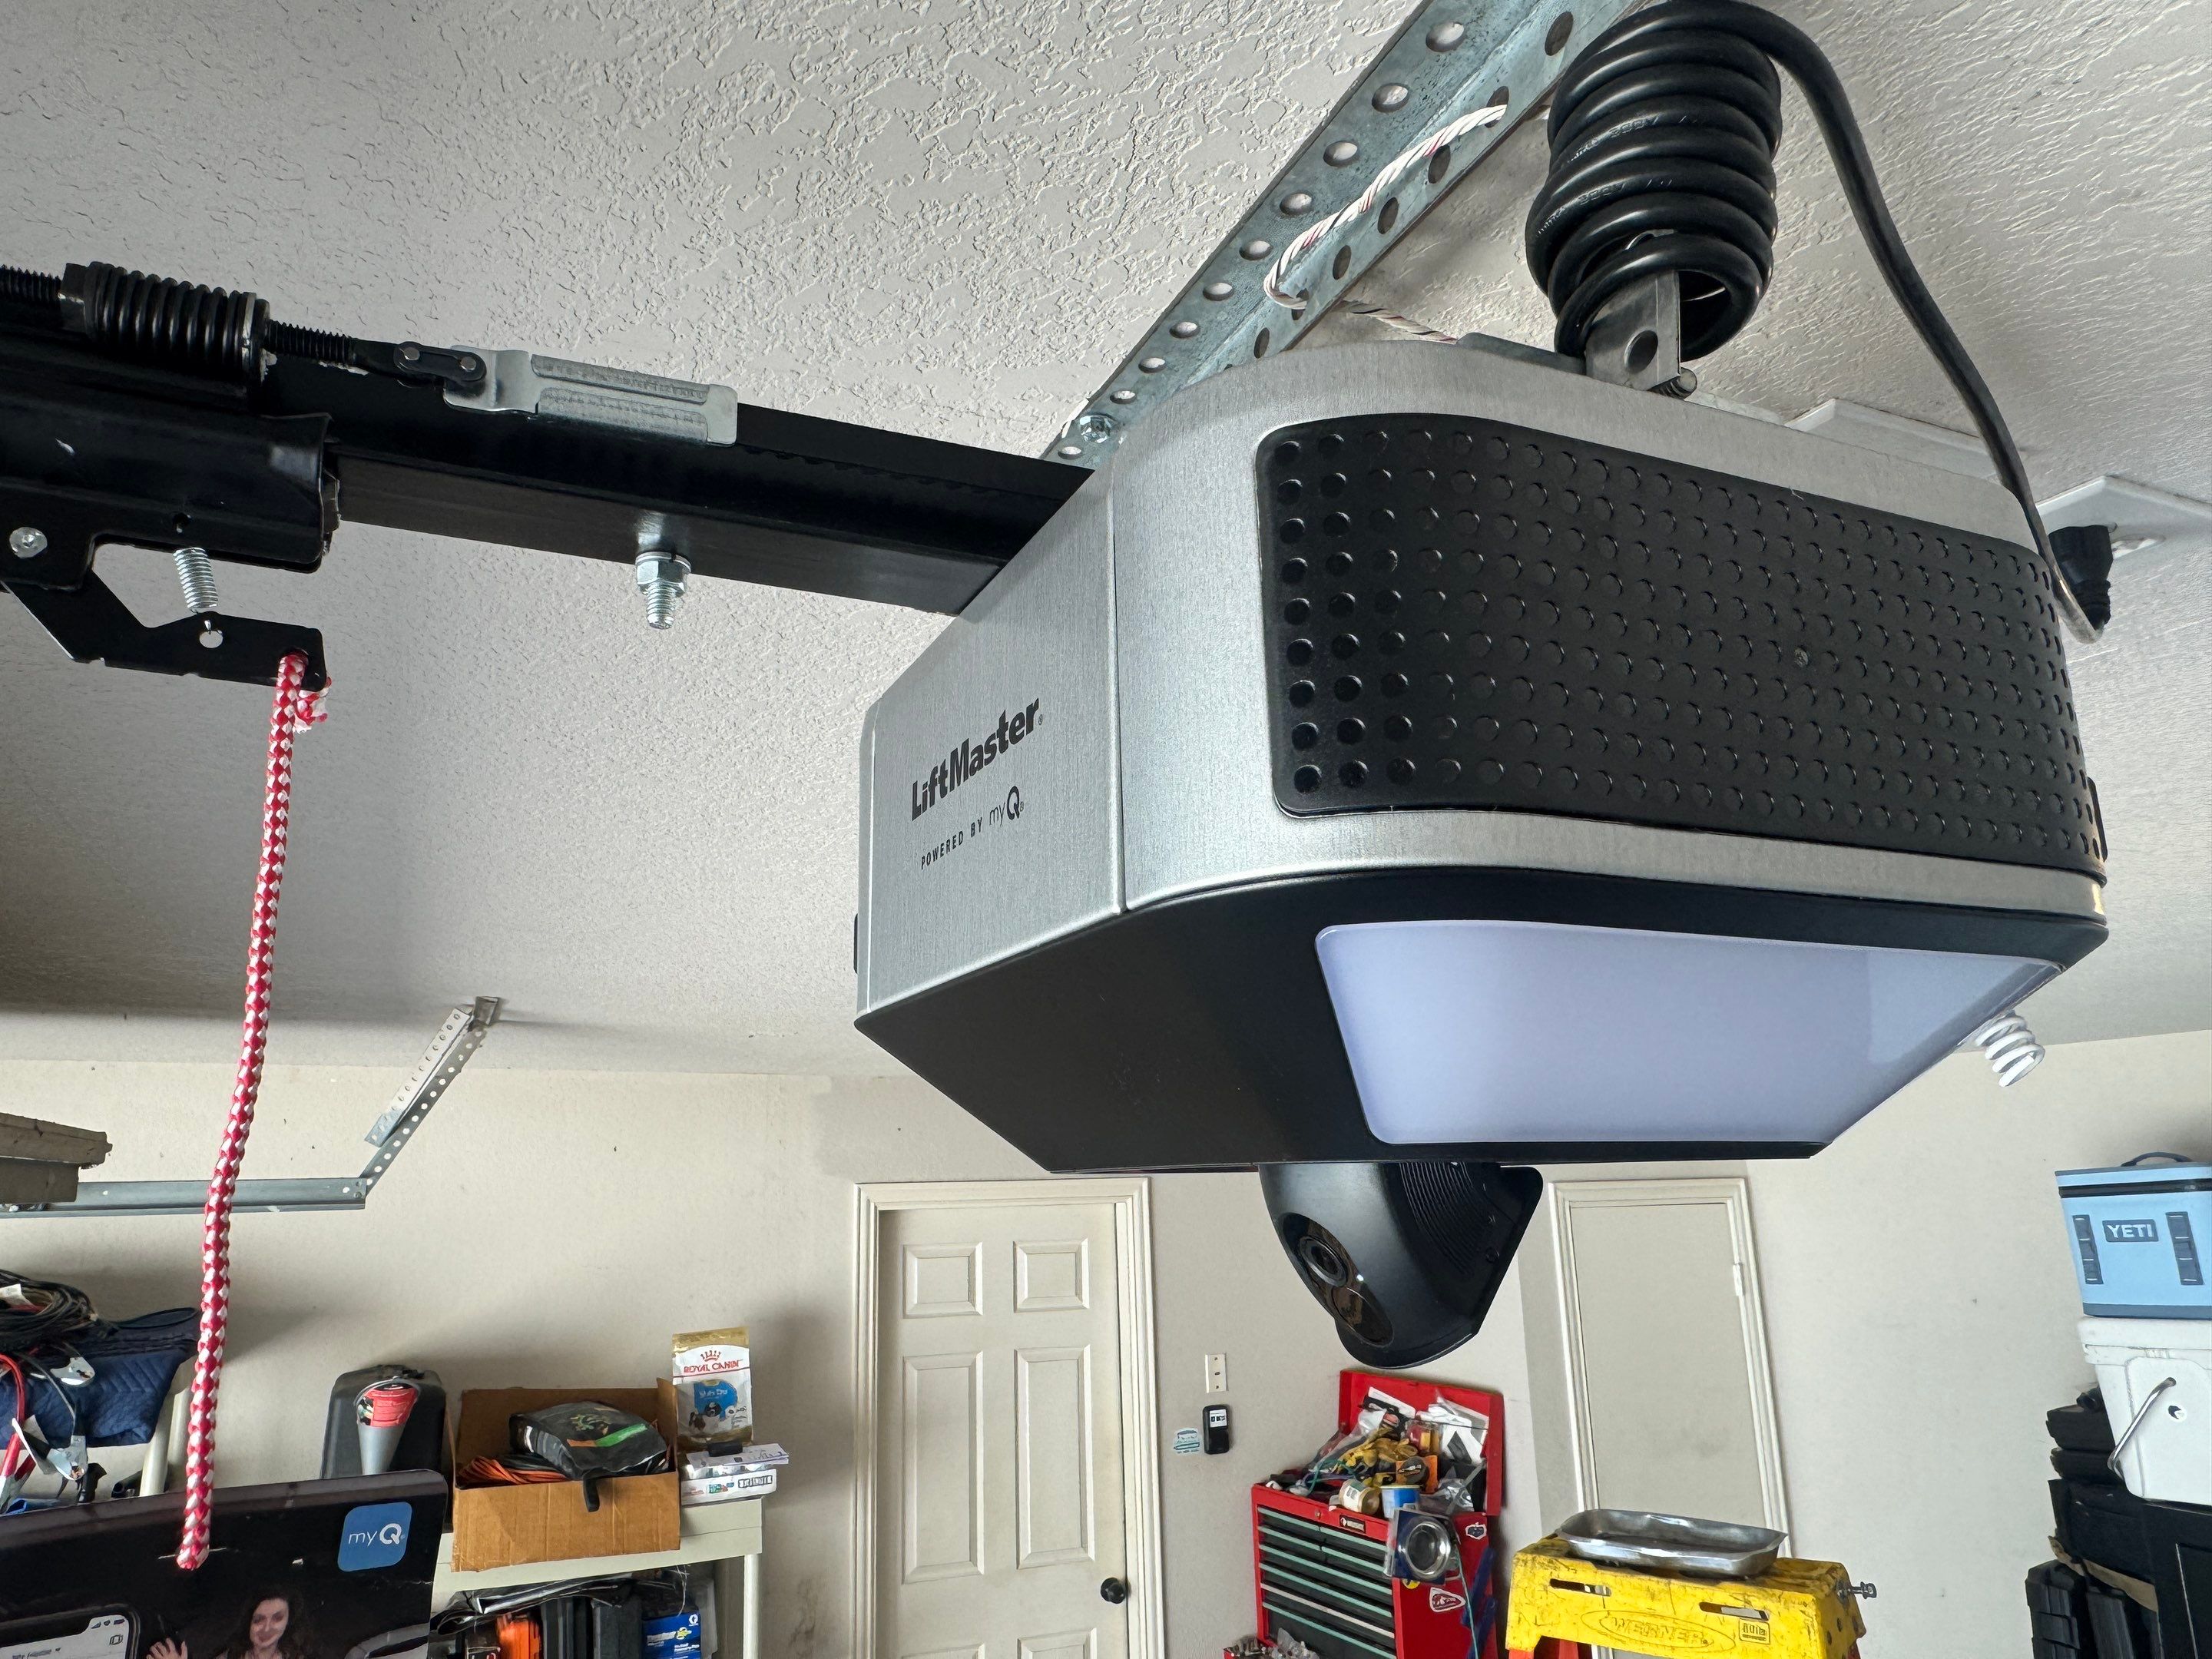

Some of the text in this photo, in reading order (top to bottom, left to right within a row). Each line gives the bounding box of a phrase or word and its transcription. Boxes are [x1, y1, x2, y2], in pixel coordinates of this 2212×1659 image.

[912, 697, 1039, 821] LiftMaster
[921, 786, 1020, 869] POWERED BY myQ
[2107, 1224, 2154, 1238] YETI
[349, 1523, 402, 1547] myQ
